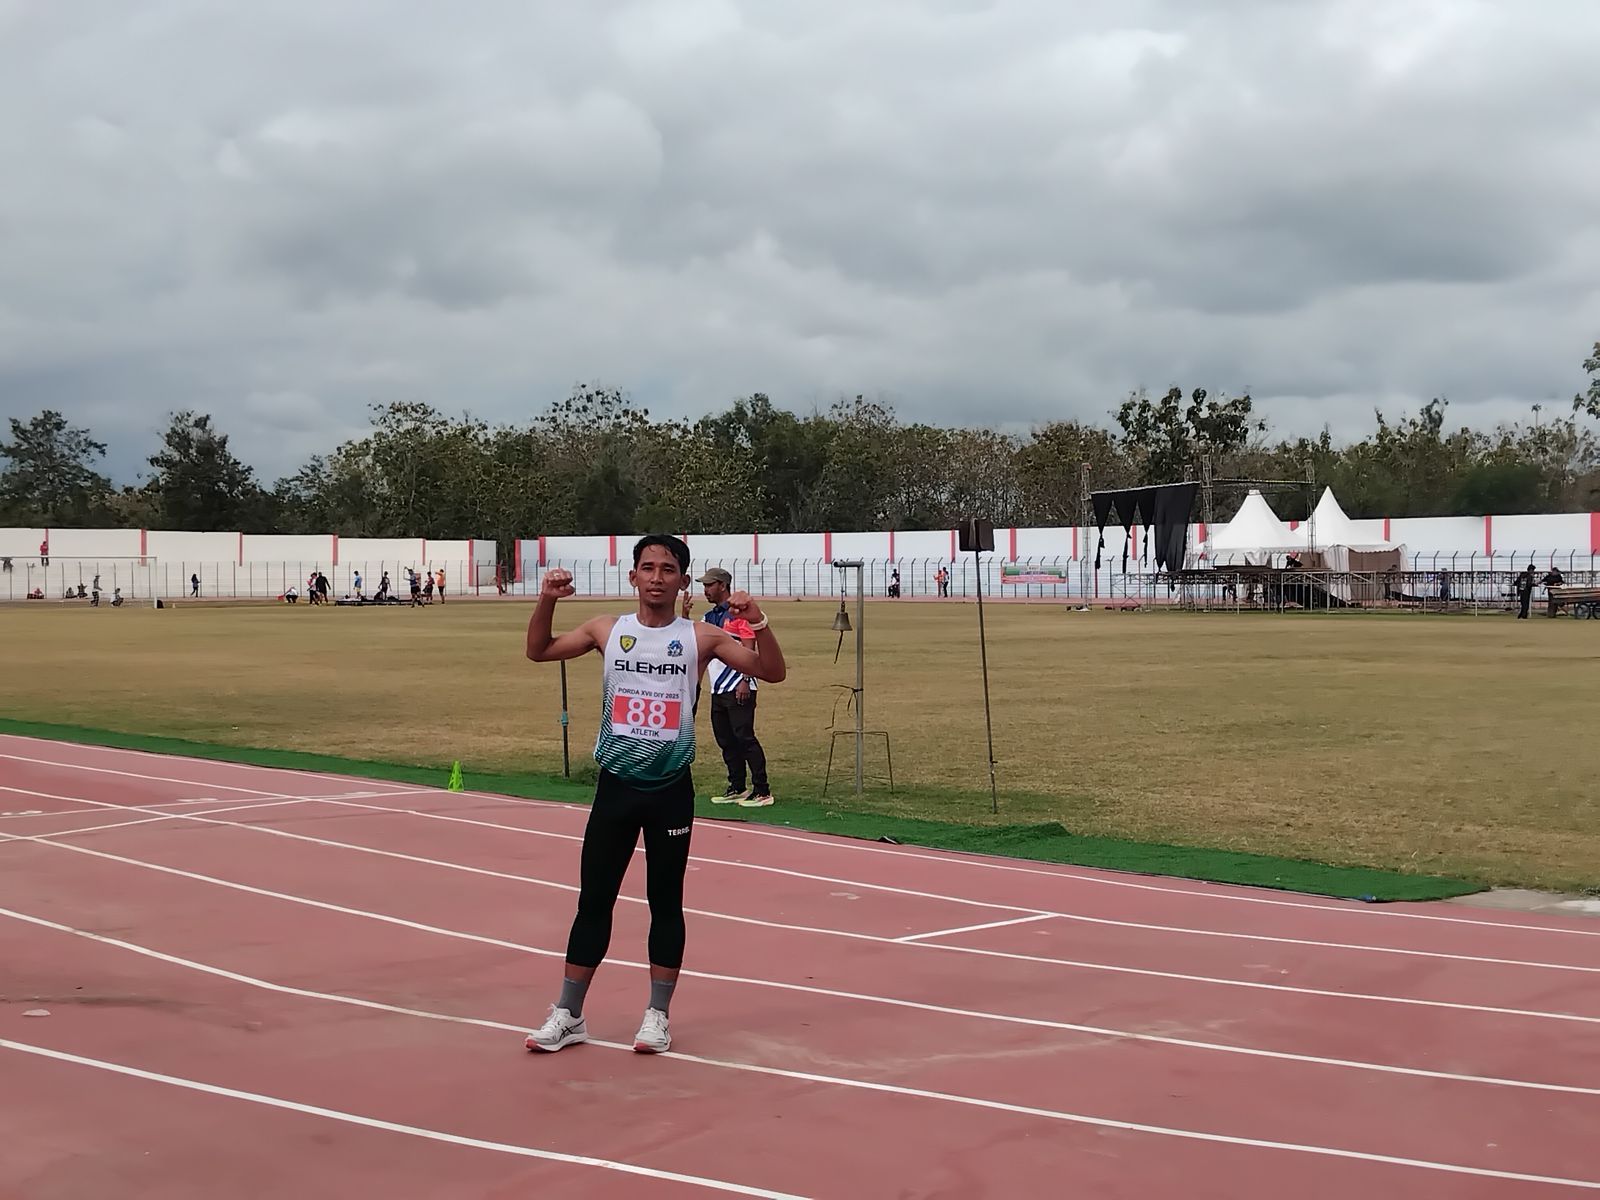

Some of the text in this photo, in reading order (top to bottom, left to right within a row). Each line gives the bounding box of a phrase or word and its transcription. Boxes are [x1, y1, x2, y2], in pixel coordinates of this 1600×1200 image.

[615, 659, 687, 675] SLEMAN
[618, 687, 640, 695] PORDA
[627, 697, 667, 729] 88
[630, 727, 660, 738] ATLETIK
